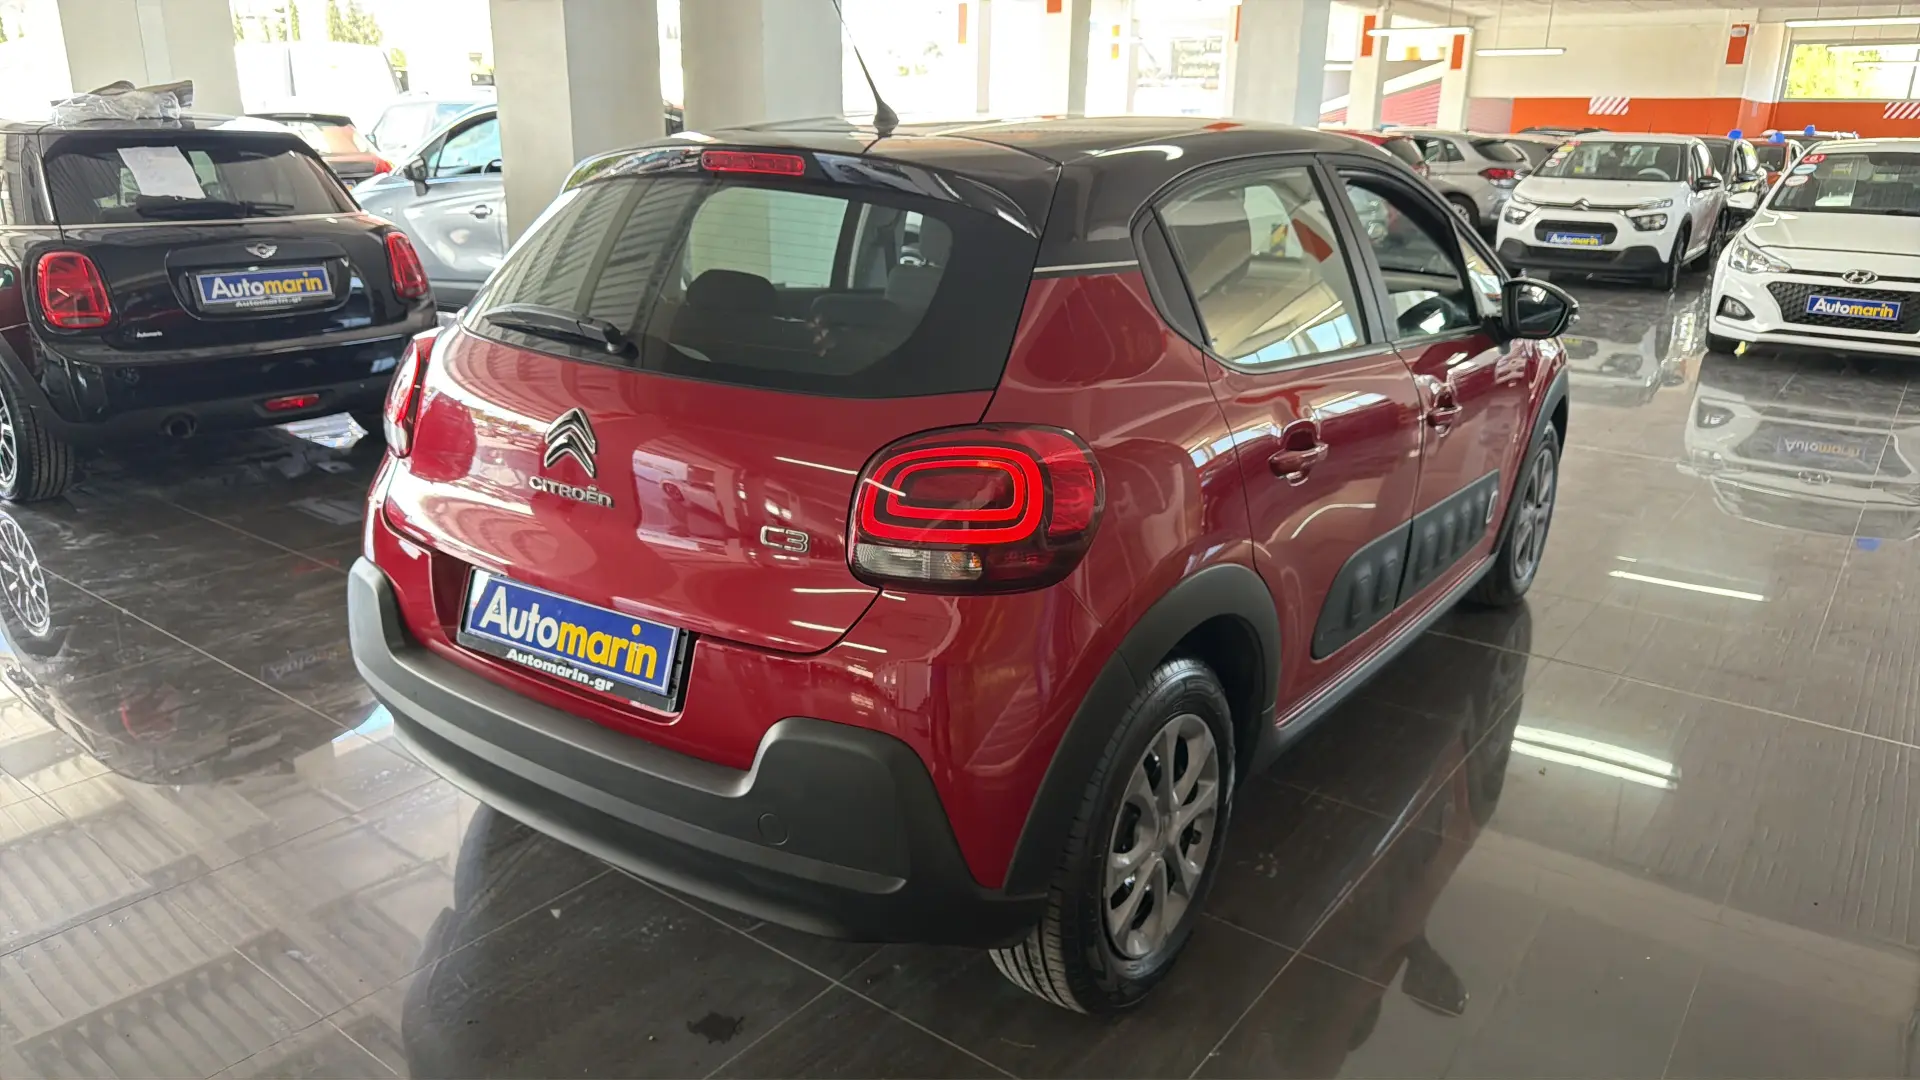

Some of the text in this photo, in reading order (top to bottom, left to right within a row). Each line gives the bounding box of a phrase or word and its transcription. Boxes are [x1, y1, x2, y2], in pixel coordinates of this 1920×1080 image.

[1550, 232, 1599, 246] Automarin
[211, 271, 323, 299] Automarin
[1812, 297, 1894, 318] Automarin
[759, 525, 810, 554] C3
[478, 585, 658, 680] Automarin
[506, 647, 614, 692] Automarin.gr
